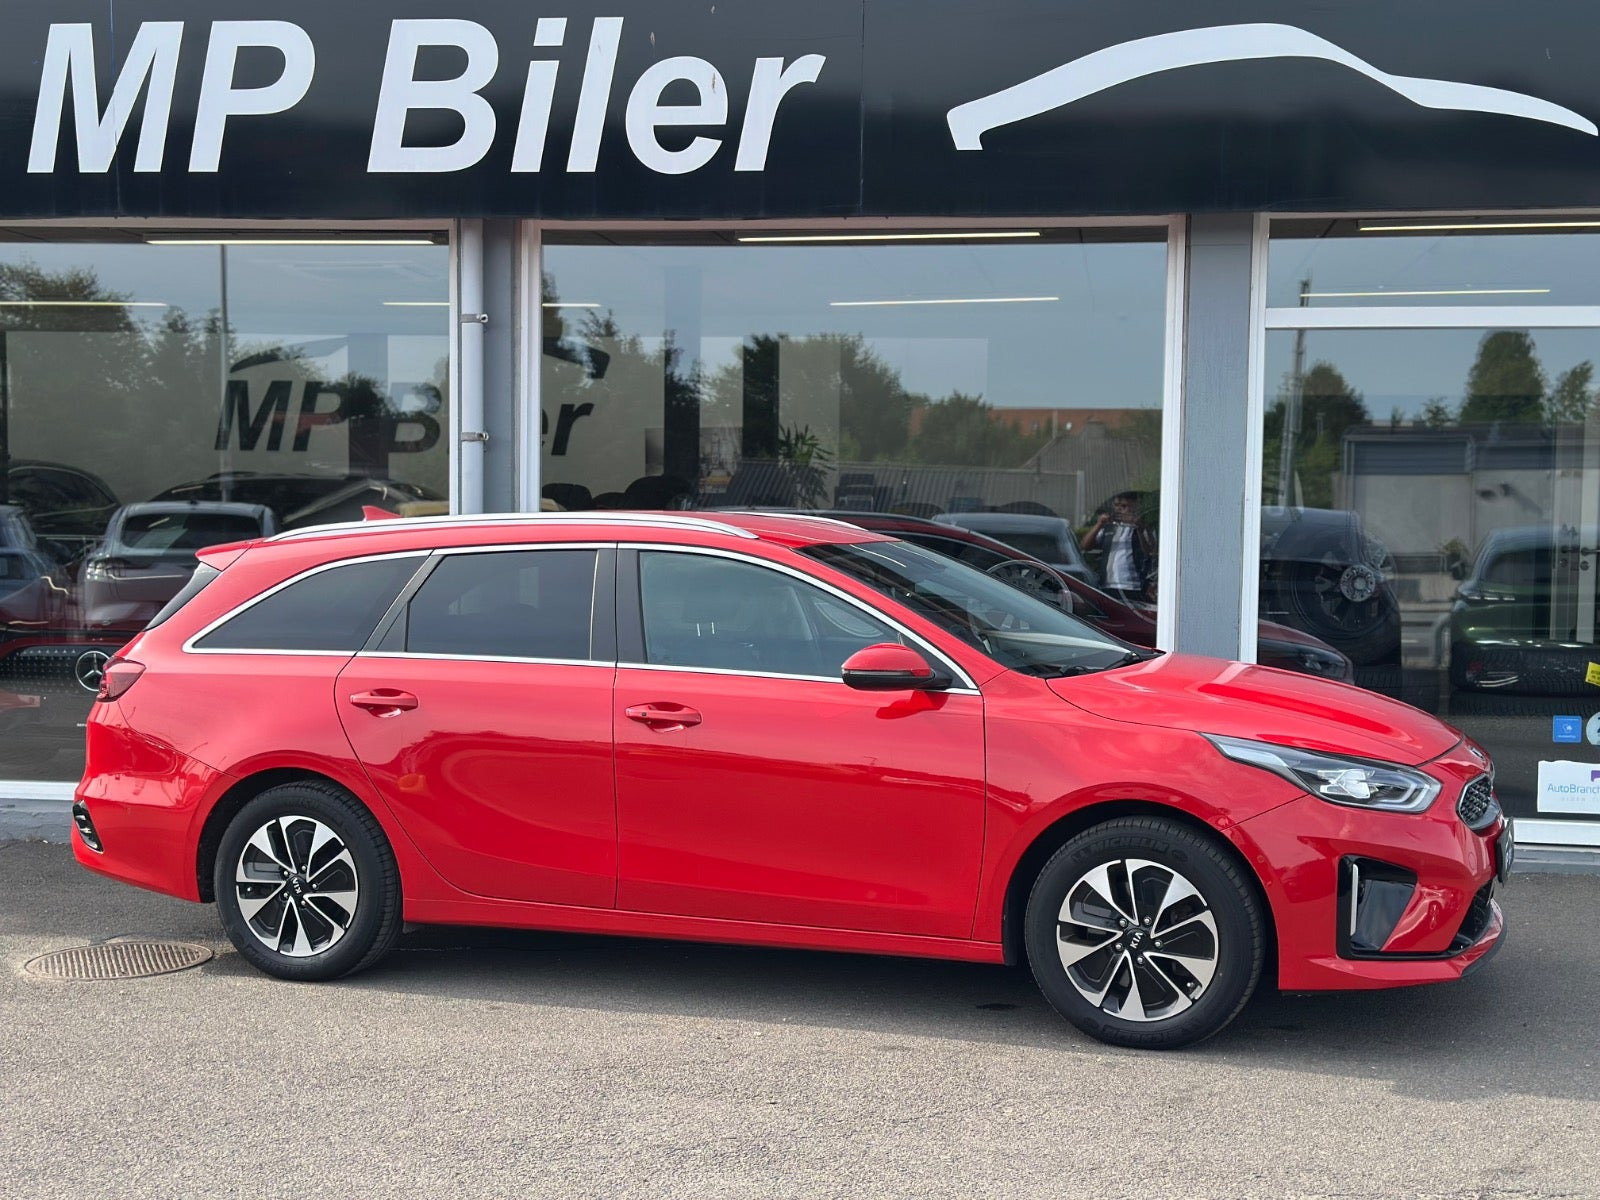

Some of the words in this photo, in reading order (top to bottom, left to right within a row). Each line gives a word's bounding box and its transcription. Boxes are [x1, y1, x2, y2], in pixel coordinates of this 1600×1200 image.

[27, 20, 316, 173] MP
[367, 16, 827, 175] Biler
[213, 380, 348, 452] MP
[1129, 932, 1144, 949] KIA
